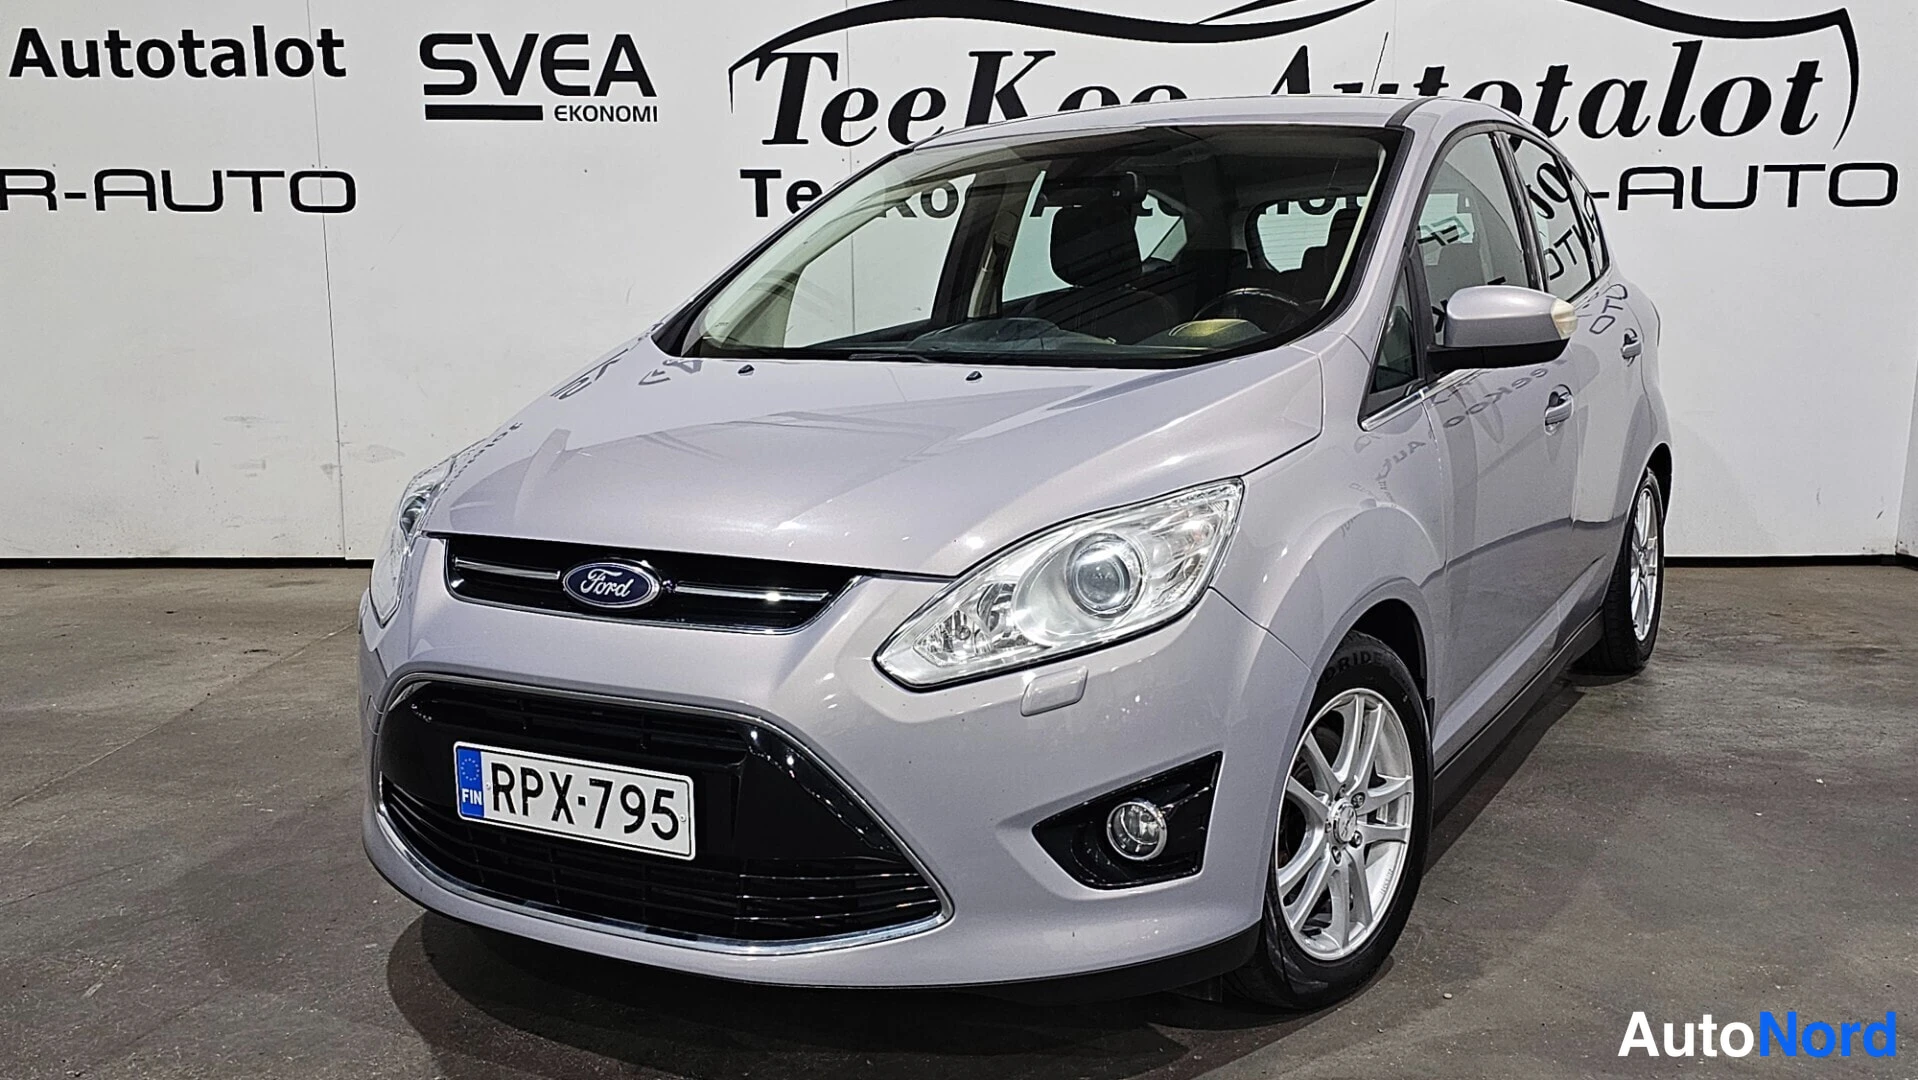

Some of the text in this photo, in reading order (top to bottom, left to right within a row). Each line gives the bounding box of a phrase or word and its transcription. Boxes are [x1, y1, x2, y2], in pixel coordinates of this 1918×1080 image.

[10, 26, 346, 78] Autotalot
[420, 34, 656, 96] SVEA
[555, 106, 657, 122] EKONOMI
[580, 567, 634, 597] Ford
[462, 788, 482, 806] FIN
[491, 762, 679, 840] RPX-795
